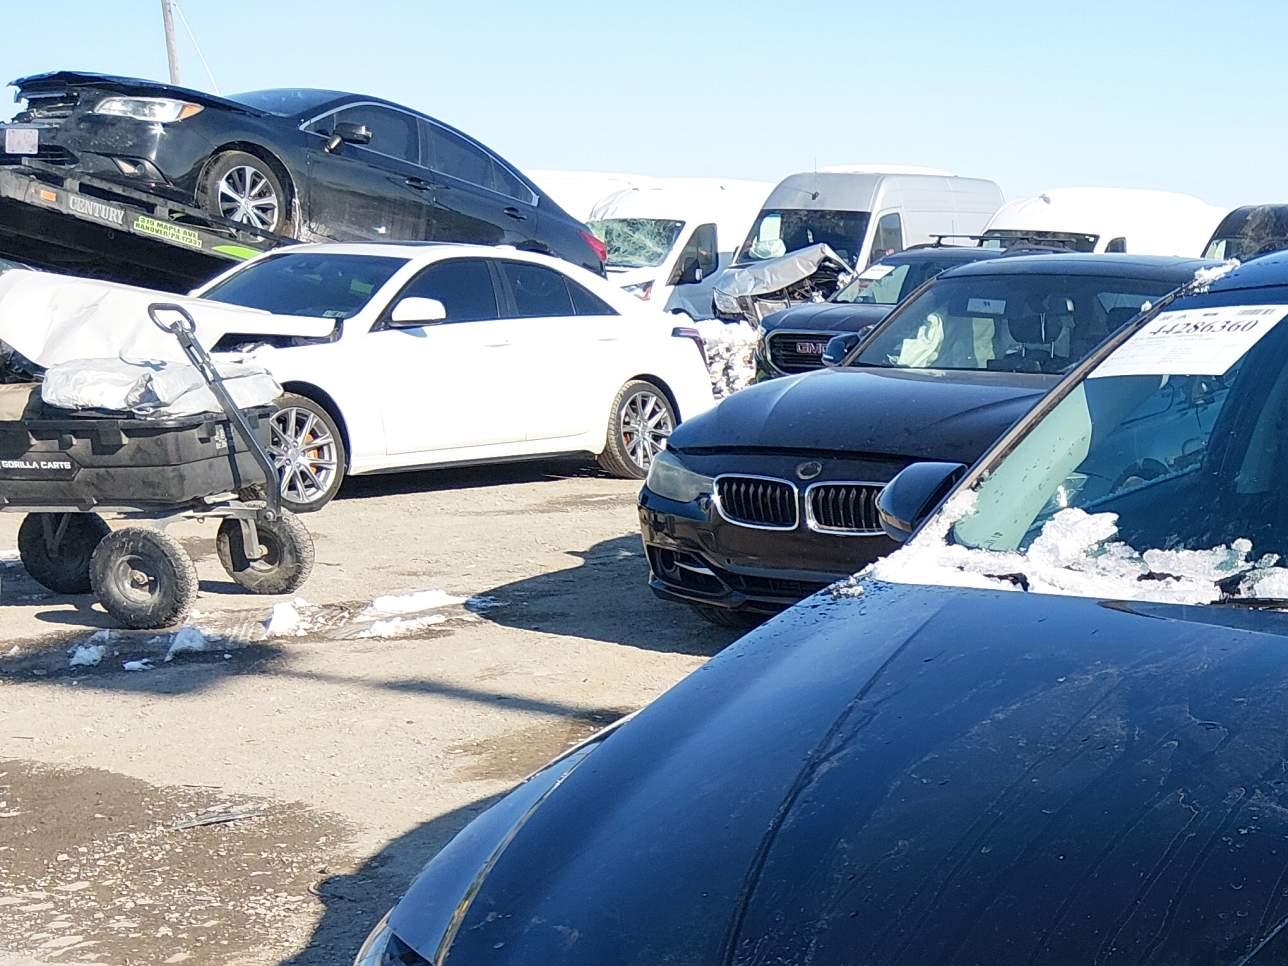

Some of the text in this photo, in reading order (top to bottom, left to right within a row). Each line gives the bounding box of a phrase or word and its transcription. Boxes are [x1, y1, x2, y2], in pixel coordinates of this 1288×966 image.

[70, 196, 125, 225] CENTURY
[156, 222, 181, 234] MAPLE
[1149, 319, 1259, 336] 44286360
[1, 460, 72, 470] GORILLA CARTS
